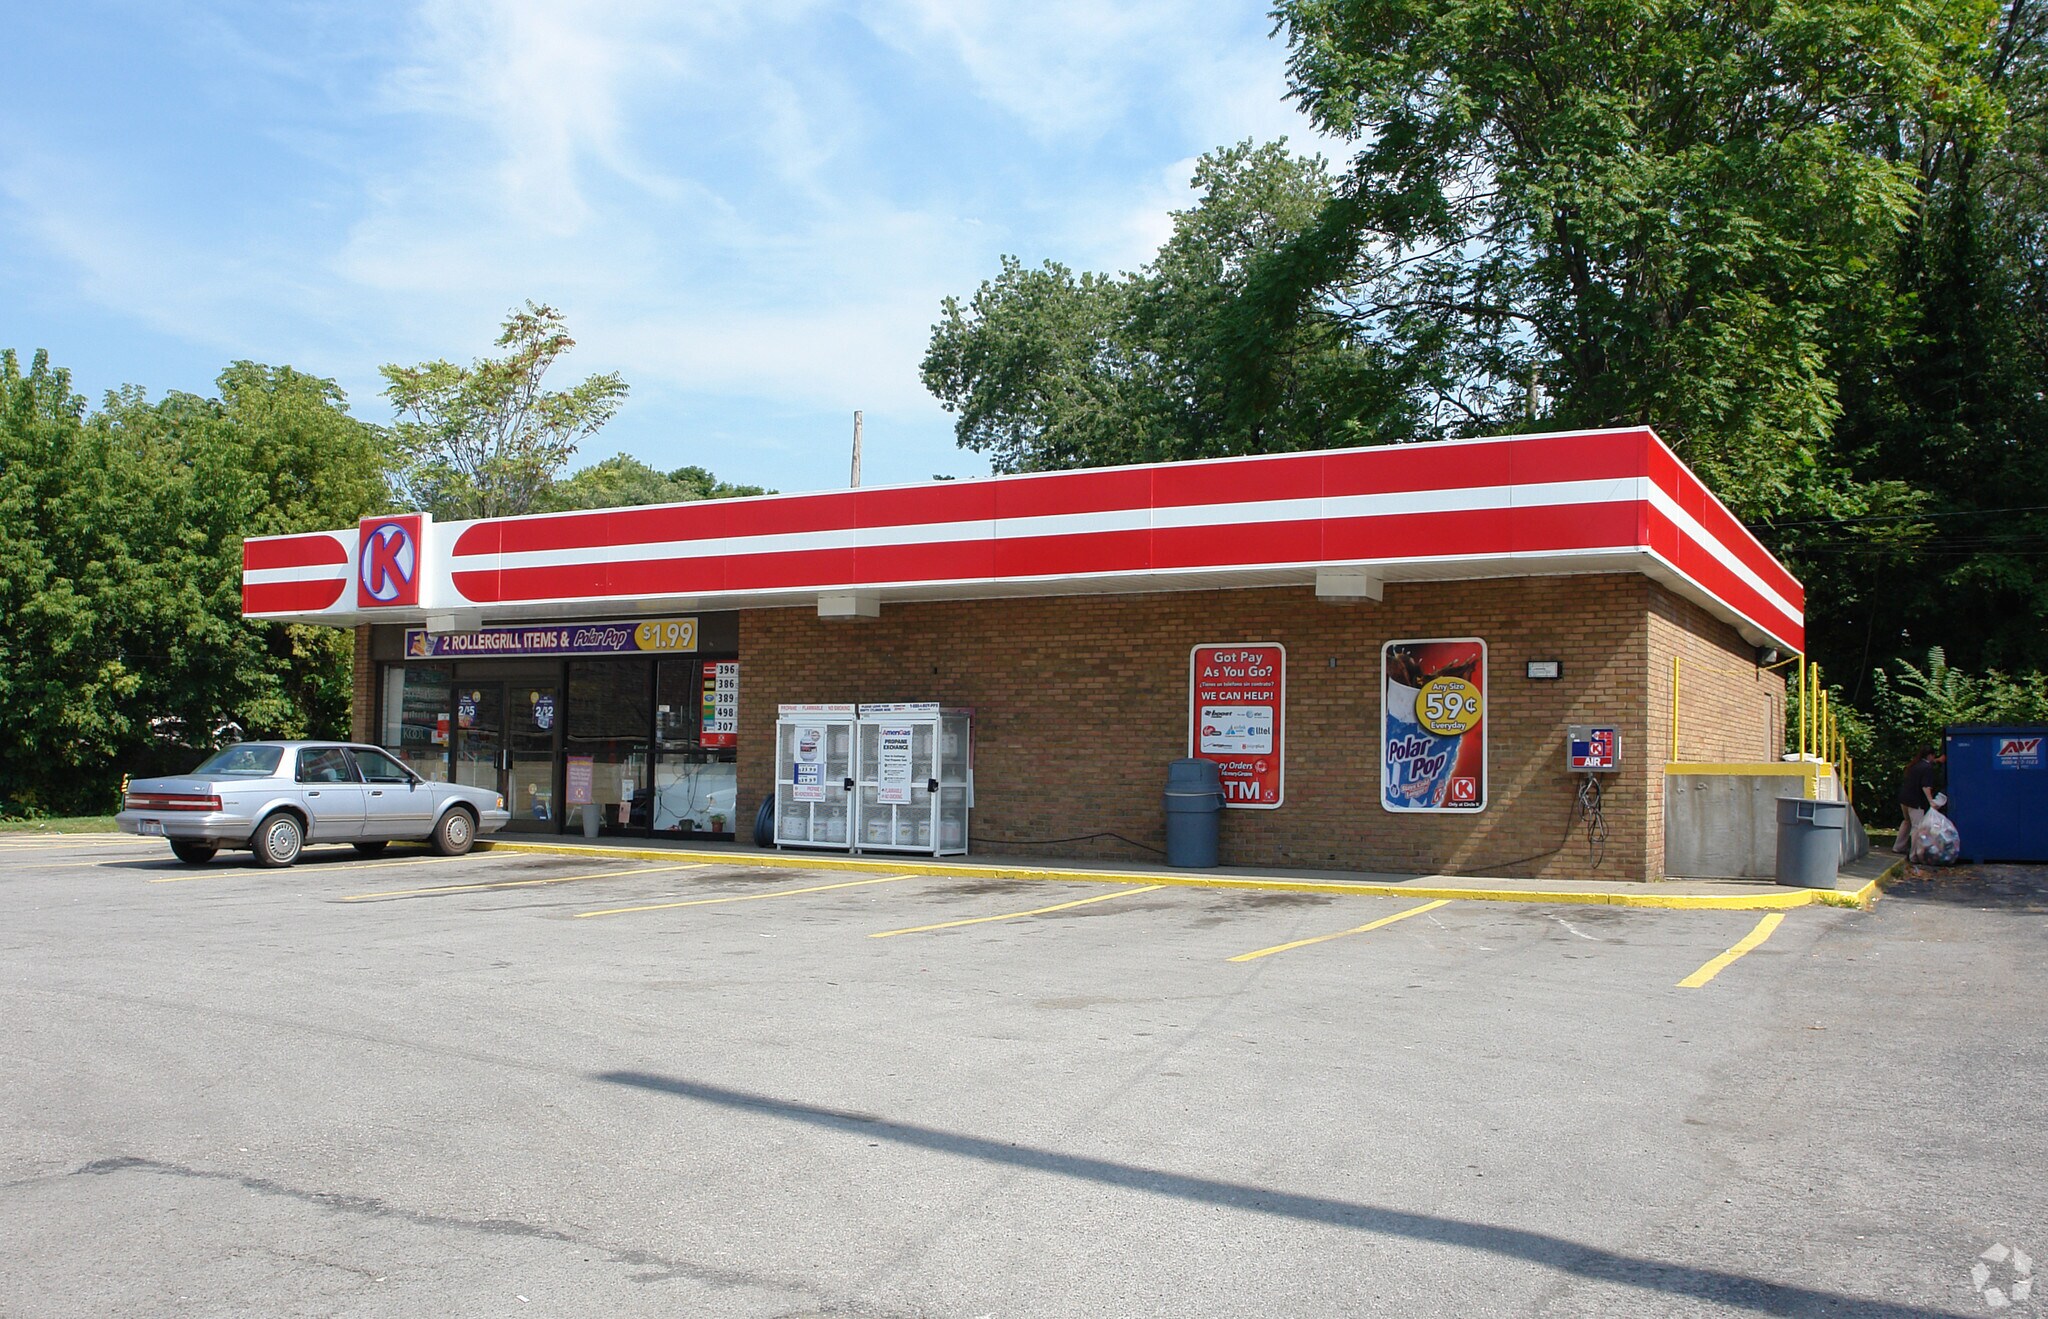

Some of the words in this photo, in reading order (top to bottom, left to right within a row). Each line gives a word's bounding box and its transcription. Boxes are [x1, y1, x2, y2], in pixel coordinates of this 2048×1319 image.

[369, 529, 411, 598] K
[443, 636, 450, 650] 2
[452, 634, 521, 650] ROLLERGRILL
[524, 632, 558, 648] ITEMS
[560, 632, 570, 647] &
[574, 628, 602, 646] Polar
[602, 627, 627, 650] Pop
[643, 623, 693, 648] $1.99
[1214, 652, 1237, 662] Got
[1240, 652, 1263, 666] Pay
[719, 665, 735, 674] 396
[1203, 666, 1220, 677] As
[1222, 666, 1244, 677] You
[1248, 666, 1273, 677] Go?
[719, 680, 734, 688] 386
[718, 694, 734, 703] 389
[1201, 691, 1217, 700] WE
[1219, 691, 1240, 700] CAN
[1244, 691, 1274, 700] HELP!
[1425, 692, 1476, 720] 59¢
[718, 708, 734, 717] 498
[717, 722, 733, 731] 307
[1430, 722, 1466, 730] Everyday
[404, 728, 425, 740] KOOL
[1389, 736, 1432, 762] Polar
[1229, 761, 1253, 769] Orders
[1410, 754, 1446, 780] Pop
[1584, 757, 1600, 766] AIR
[1222, 781, 1260, 799] TM
[1456, 780, 1472, 798] K
